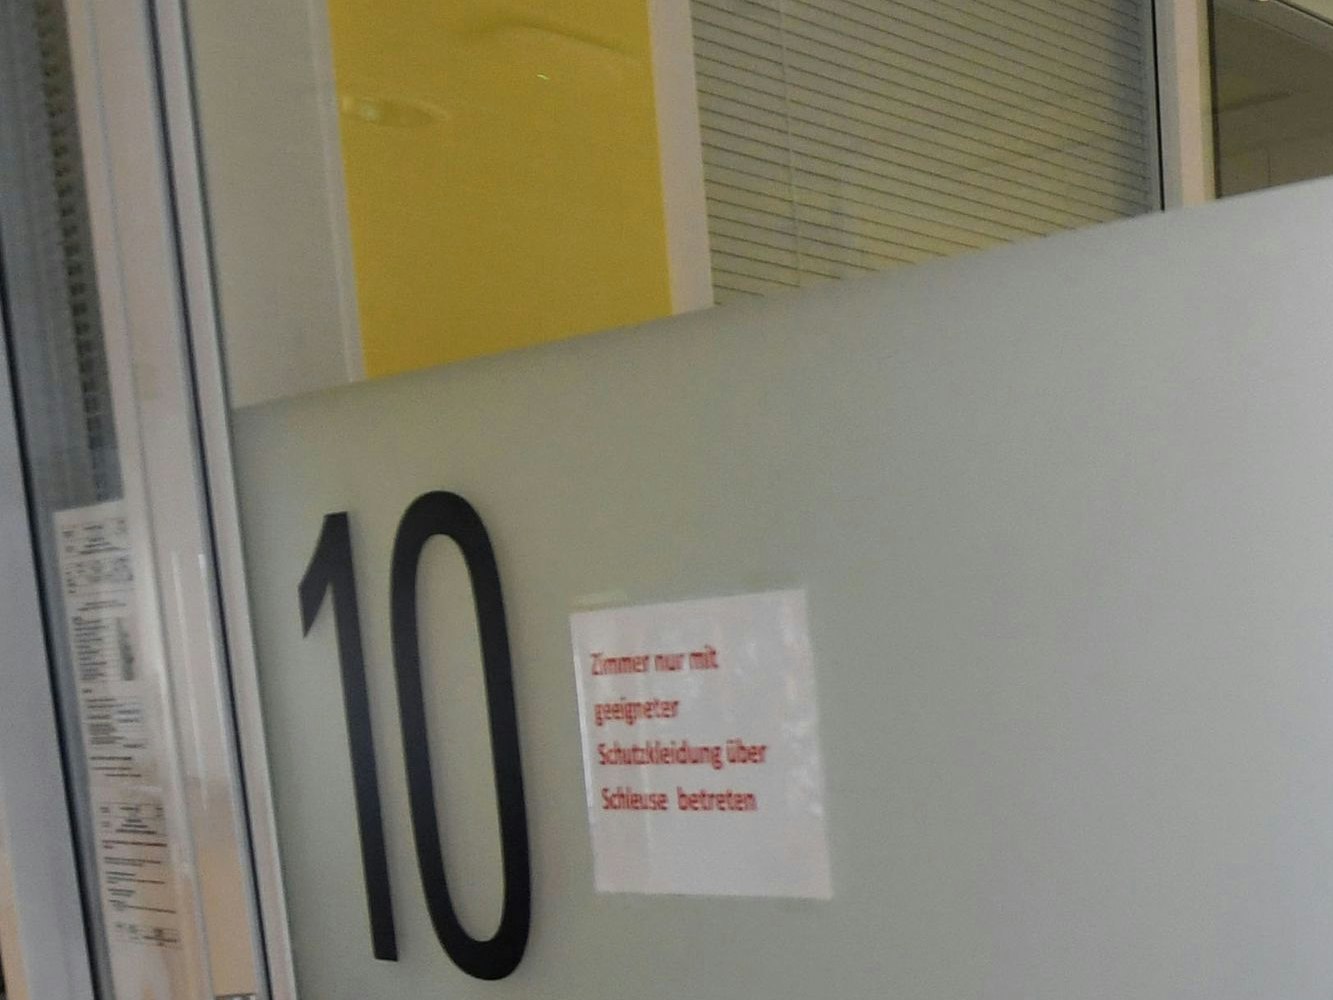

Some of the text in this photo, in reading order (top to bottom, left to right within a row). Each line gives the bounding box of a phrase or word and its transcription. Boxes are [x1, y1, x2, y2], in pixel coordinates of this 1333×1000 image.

[591, 644, 719, 675] Zimmer nur mit
[595, 697, 680, 727] geeigneter
[298, 490, 532, 981] 10
[598, 738, 767, 769] Schutzkleidung über
[601, 785, 758, 811] Schleuse betreten
